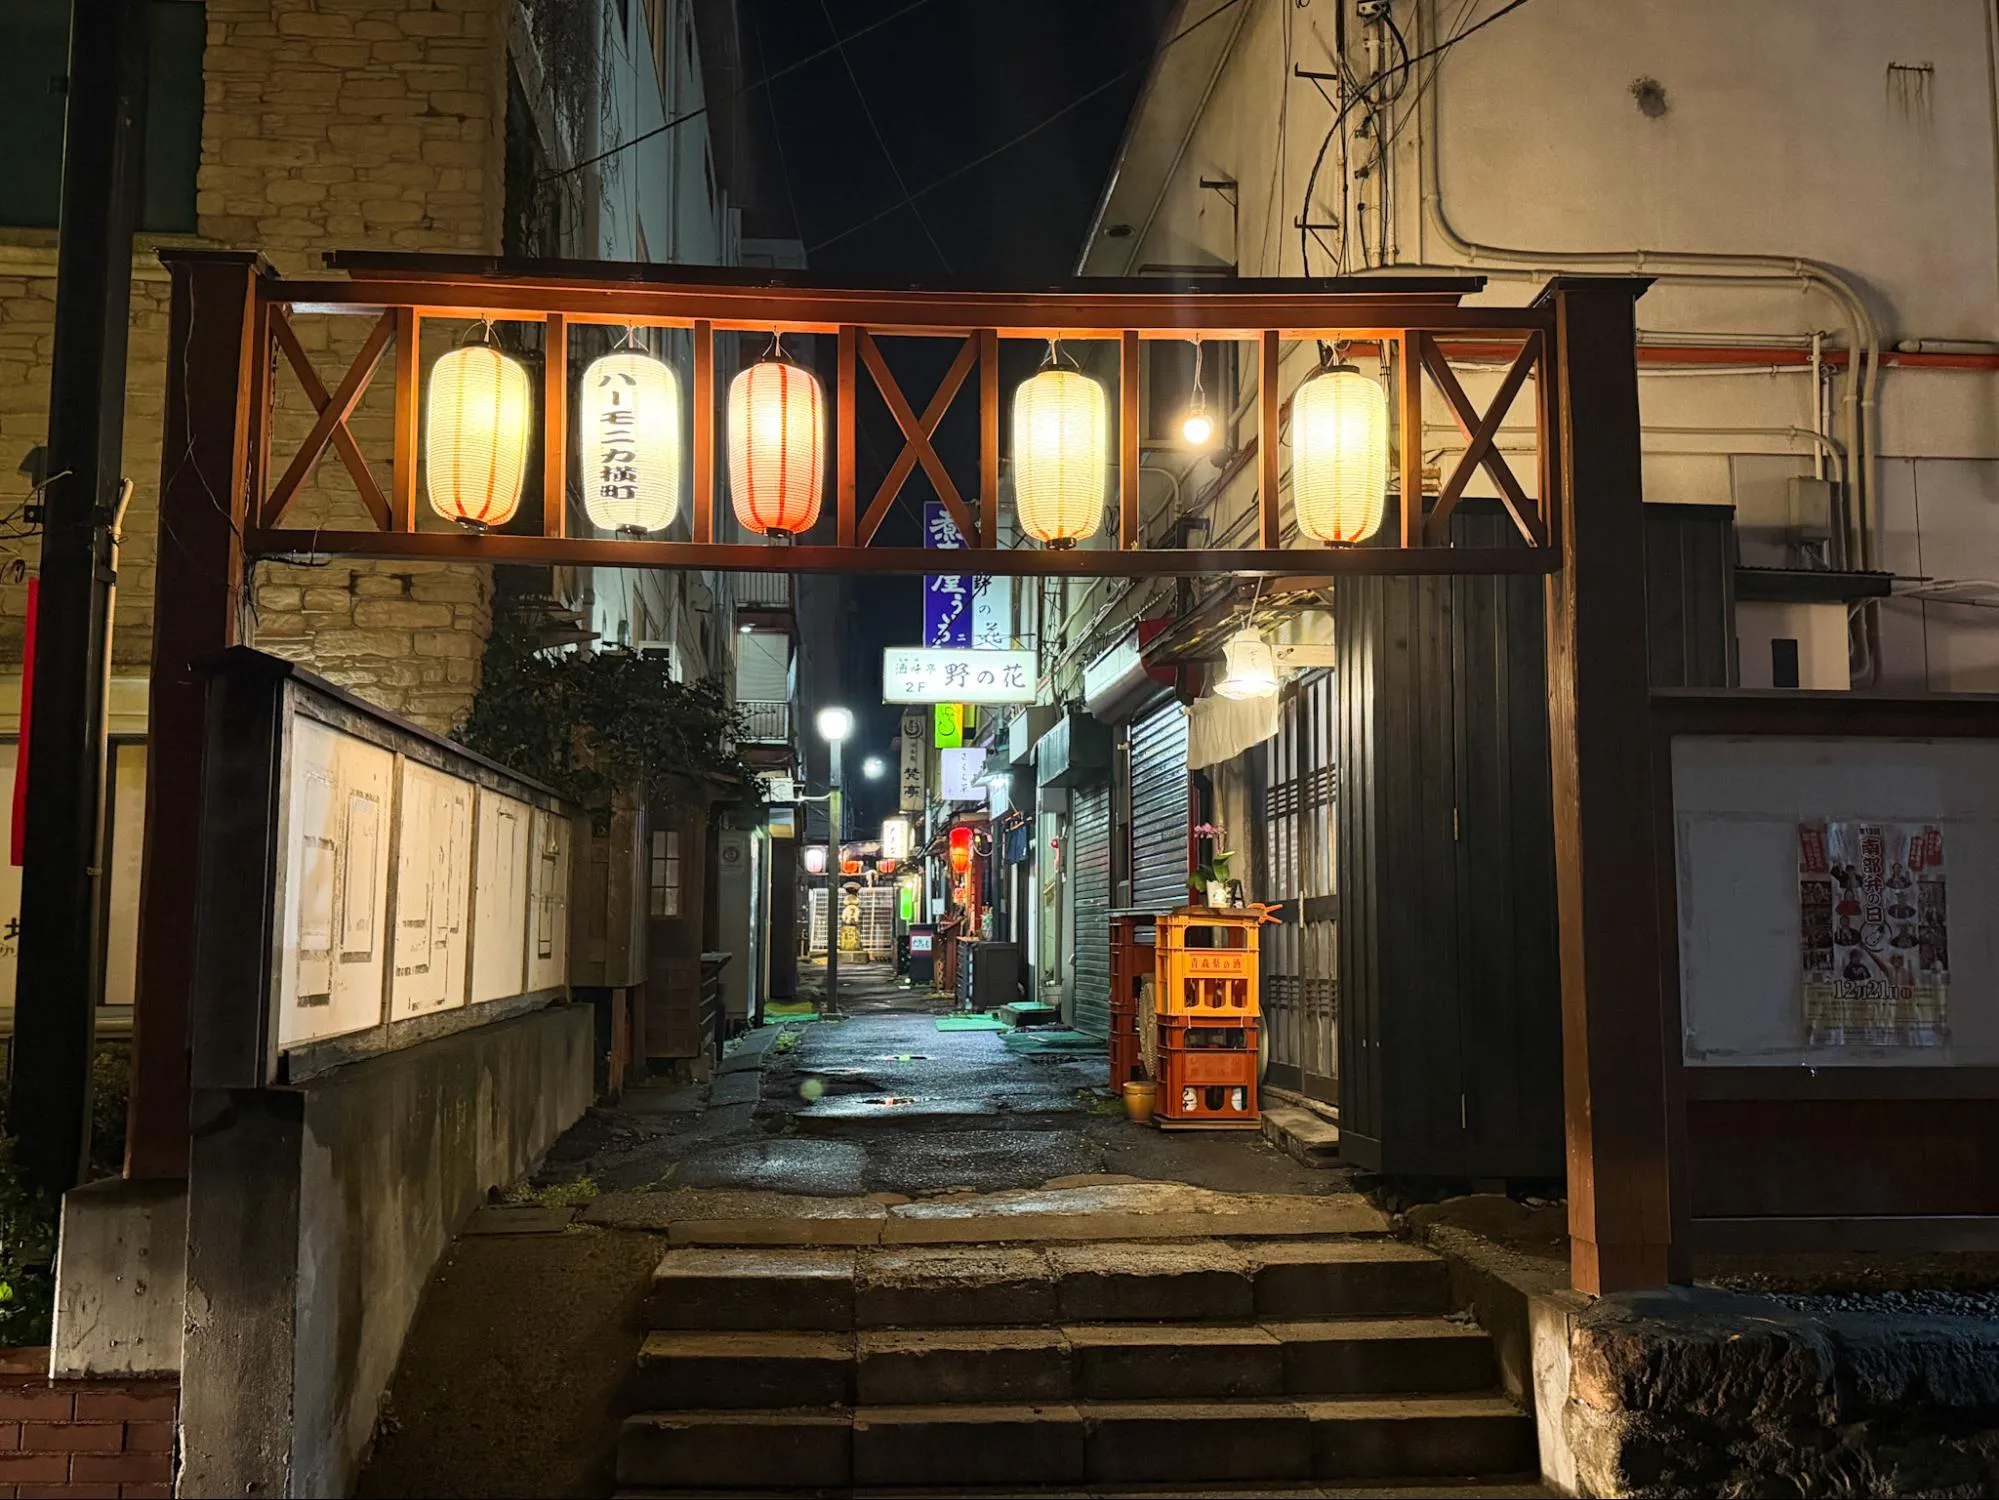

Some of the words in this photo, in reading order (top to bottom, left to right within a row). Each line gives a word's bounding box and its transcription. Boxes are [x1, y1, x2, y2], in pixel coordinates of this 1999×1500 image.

[598, 372, 638, 500] ハーモニカ横町
[905, 681, 927, 693] 2F
[944, 662, 1026, 688] 野の花
[1861, 838, 1884, 924] 南部弁の日
[1191, 957, 1242, 969] 青森県の酒
